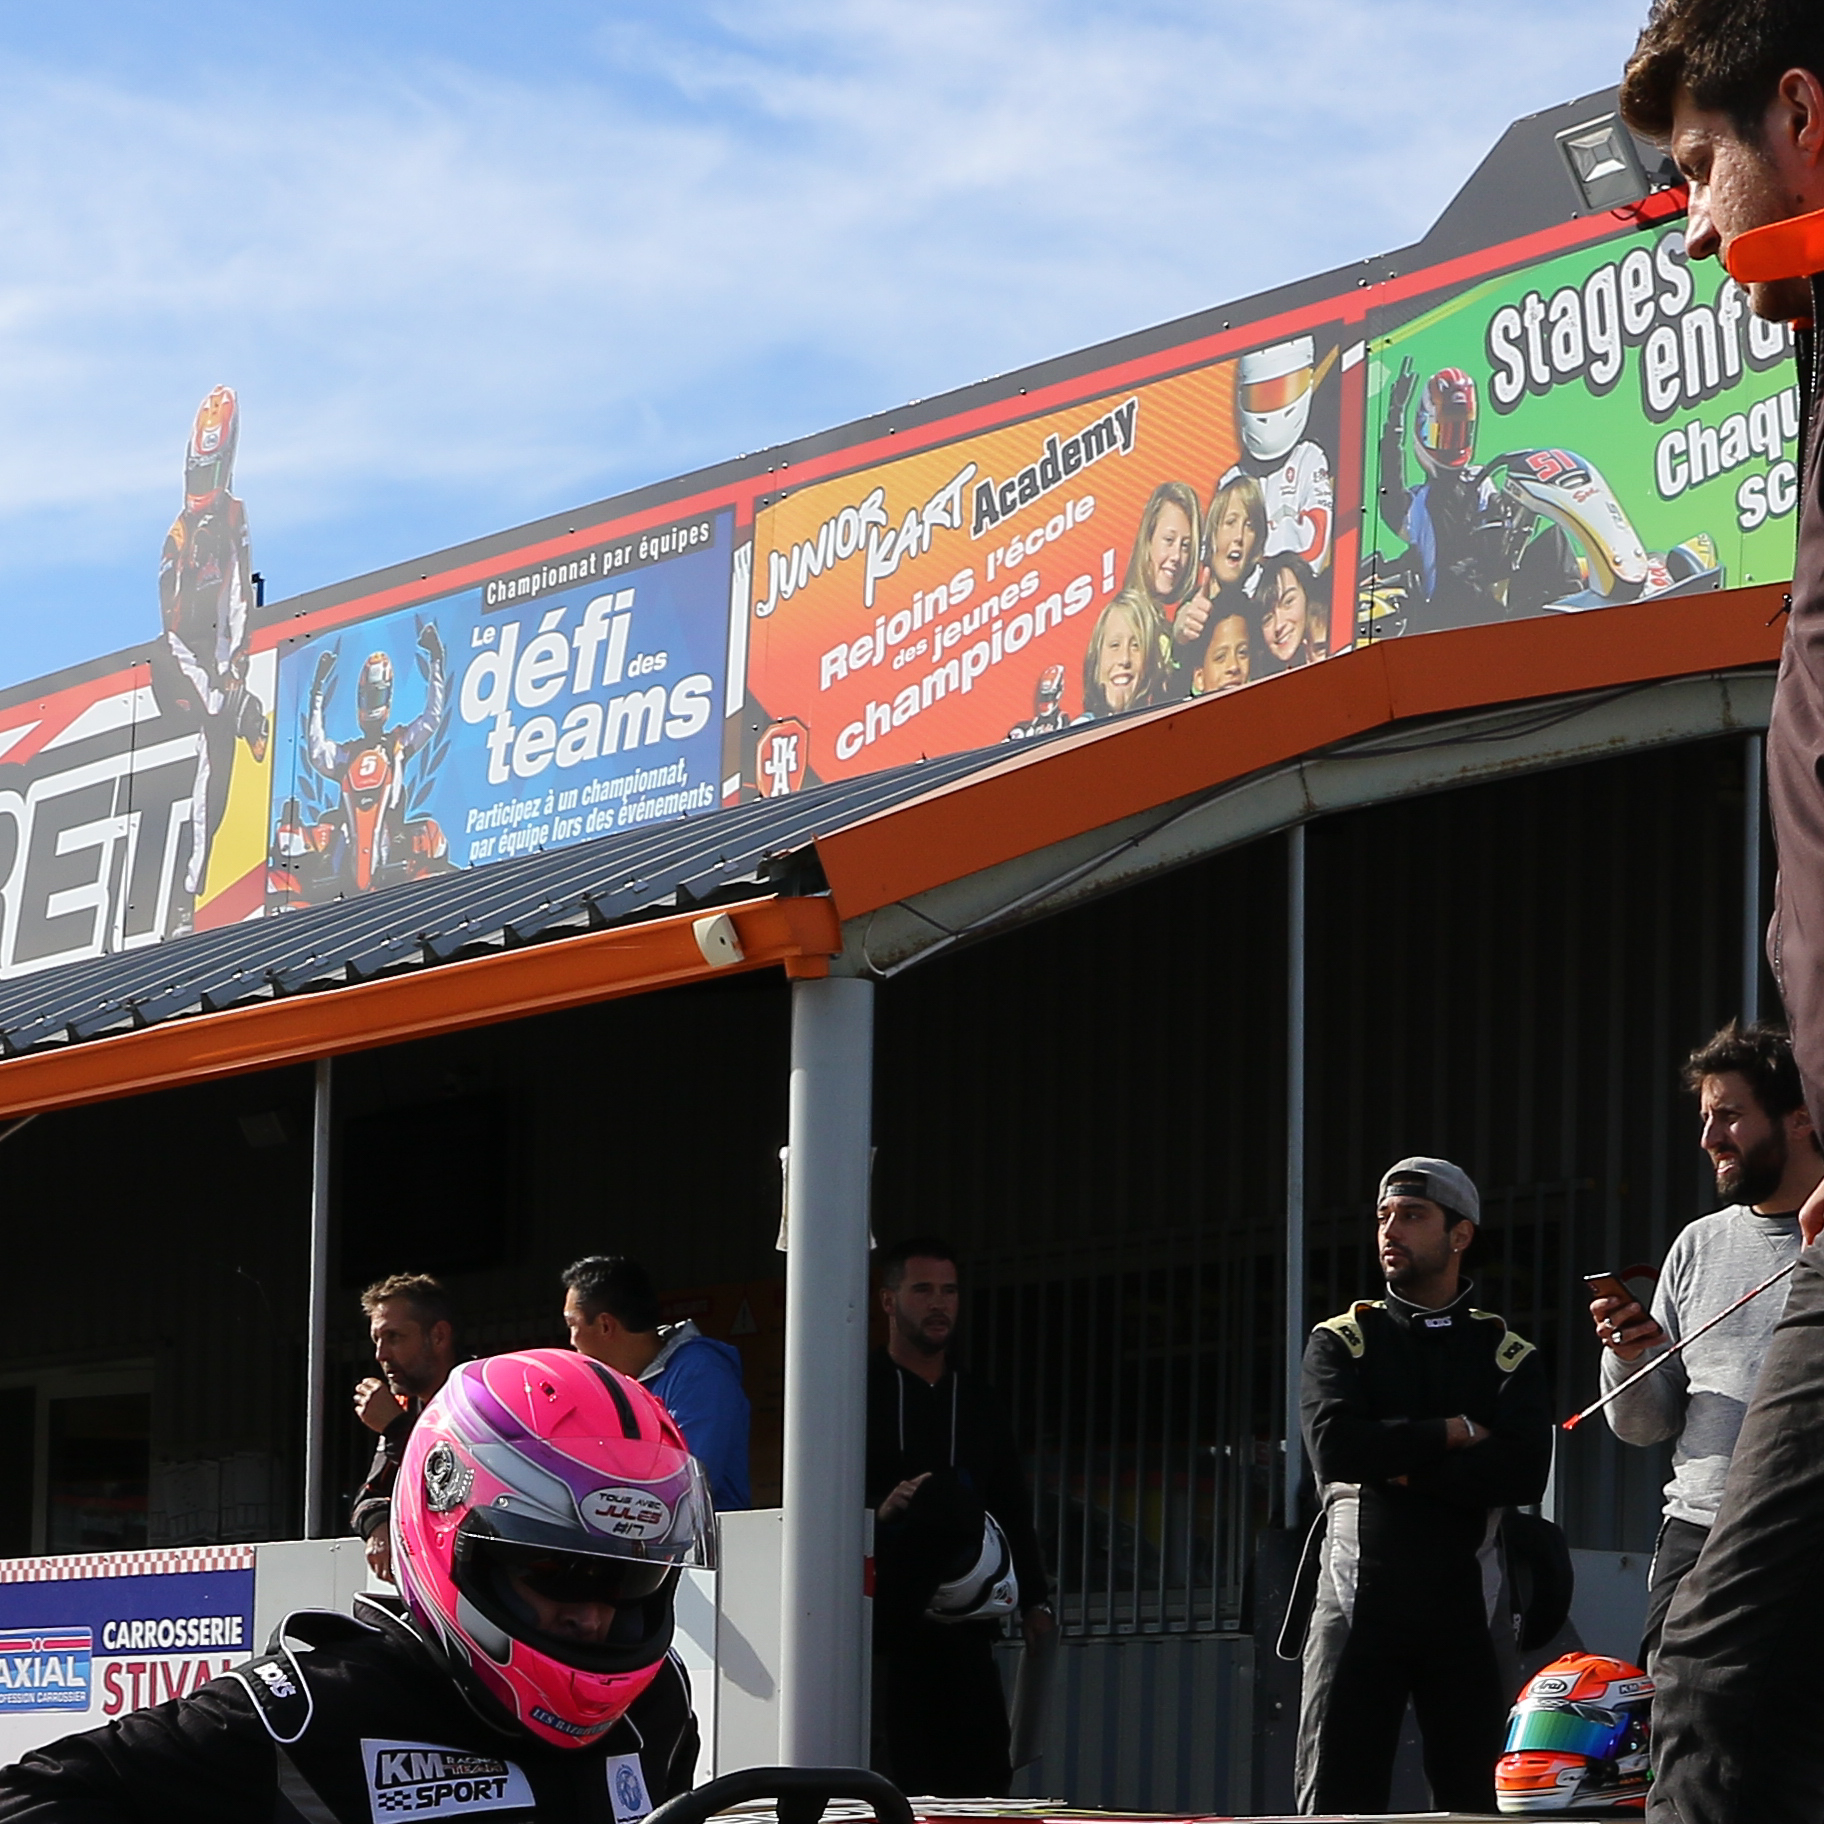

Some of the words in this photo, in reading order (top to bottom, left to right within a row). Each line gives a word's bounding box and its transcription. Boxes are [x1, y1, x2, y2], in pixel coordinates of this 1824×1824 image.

[1487, 229, 1692, 412] Stages
[1644, 282, 1796, 415] enfa
[756, 487, 888, 618] JUNIOR
[862, 461, 979, 608] KART
[970, 396, 1140, 540] Academy
[485, 556, 597, 606] Championnat
[602, 544, 632, 577] par
[638, 519, 711, 563] équipes
[819, 567, 975, 692] Rejoins
[987, 494, 1096, 584] l'école
[459, 588, 636, 727] défi
[471, 622, 497, 651] Le
[835, 584, 1095, 761] champions
[1099, 548, 1117, 595] !
[891, 636, 929, 671] des
[927, 569, 1042, 663] jeunes
[627, 650, 668, 679] des
[485, 671, 715, 786] teams
[466, 798, 541, 834] Participez
[543, 790, 555, 816] à
[557, 787, 578, 812] un
[581, 757, 689, 807] championnat,
[469, 835, 496, 862] par
[498, 822, 548, 858] équipe
[551, 814, 582, 843] lors
[585, 806, 615, 834] des
[617, 782, 716, 828] événements
[595, 1507, 665, 1526] JULES
[599, 1492, 634, 1504] TOUS
[635, 1498, 663, 1511] AVEC
[102, 1616, 243, 1650] CARROSSERIE
[37, 1690, 87, 1703] CARROSSIER
[102, 1658, 232, 1716] STIVA
[381, 1752, 446, 1785] KM
[446, 1755, 500, 1765] RACING
[415, 1777, 508, 1809] SPORT
